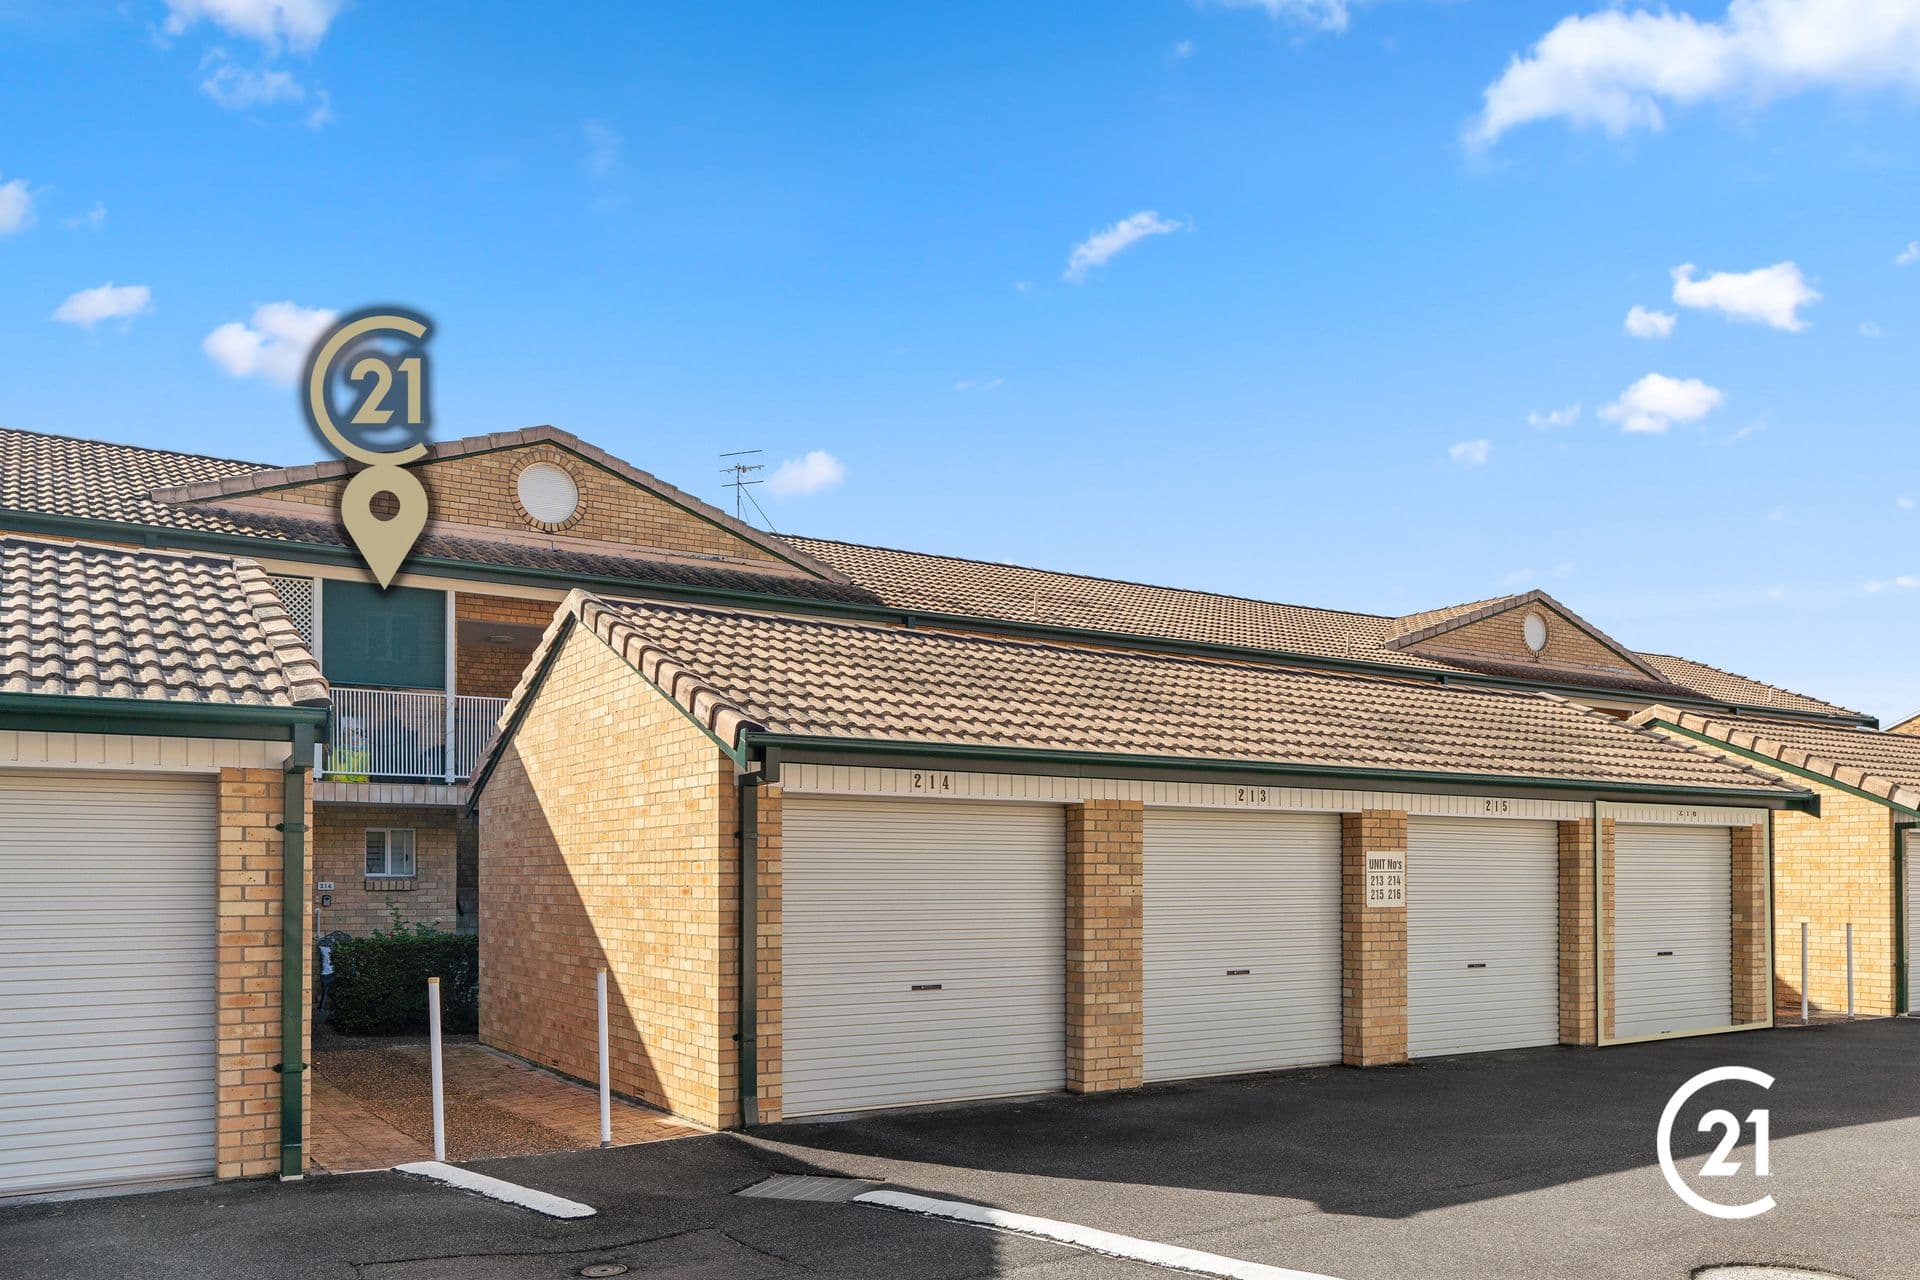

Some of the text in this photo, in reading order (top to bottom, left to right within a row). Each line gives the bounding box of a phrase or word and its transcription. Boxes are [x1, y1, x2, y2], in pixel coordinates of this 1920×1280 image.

[914, 773, 949, 790] 214
[1238, 788, 1266, 802] 213
[1486, 800, 1508, 812] 215
[1369, 858, 1403, 870] UNIT No's
[1370, 875, 1401, 886] 213 214
[1370, 888, 1402, 900] 215 216
